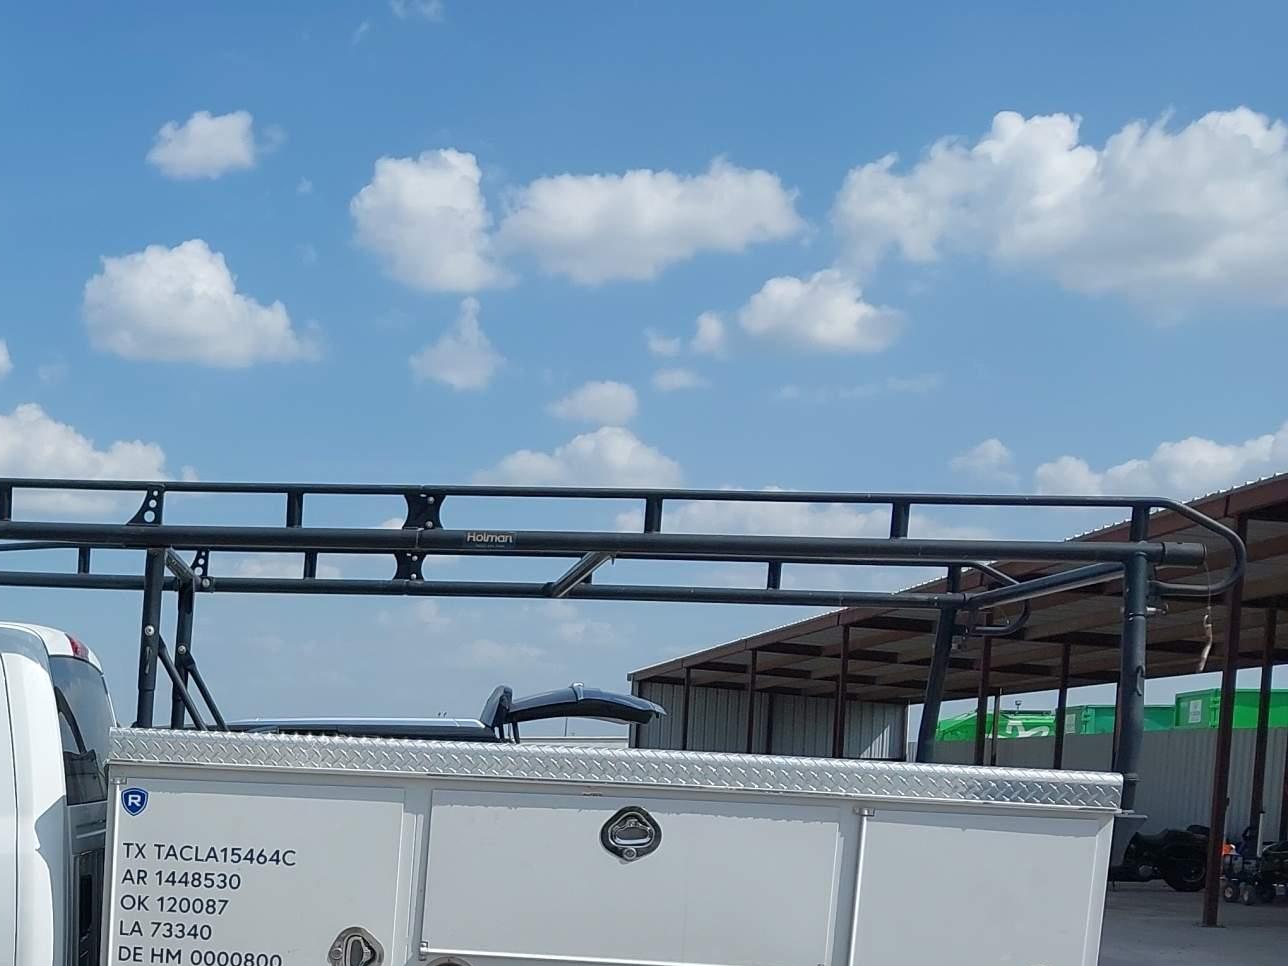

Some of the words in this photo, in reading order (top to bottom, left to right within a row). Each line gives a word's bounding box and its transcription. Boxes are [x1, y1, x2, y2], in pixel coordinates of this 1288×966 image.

[466, 531, 513, 543] Holman
[122, 843, 147, 860] TX
[154, 844, 297, 867] TACLA15464C
[121, 869, 148, 886] AR
[155, 870, 242, 891] 1448530
[120, 895, 150, 912] OK
[156, 896, 230, 916] 120087
[119, 920, 143, 937] LA
[150, 922, 212, 941] 73340
[118, 946, 144, 963] DE
[150, 948, 182, 965] HM
